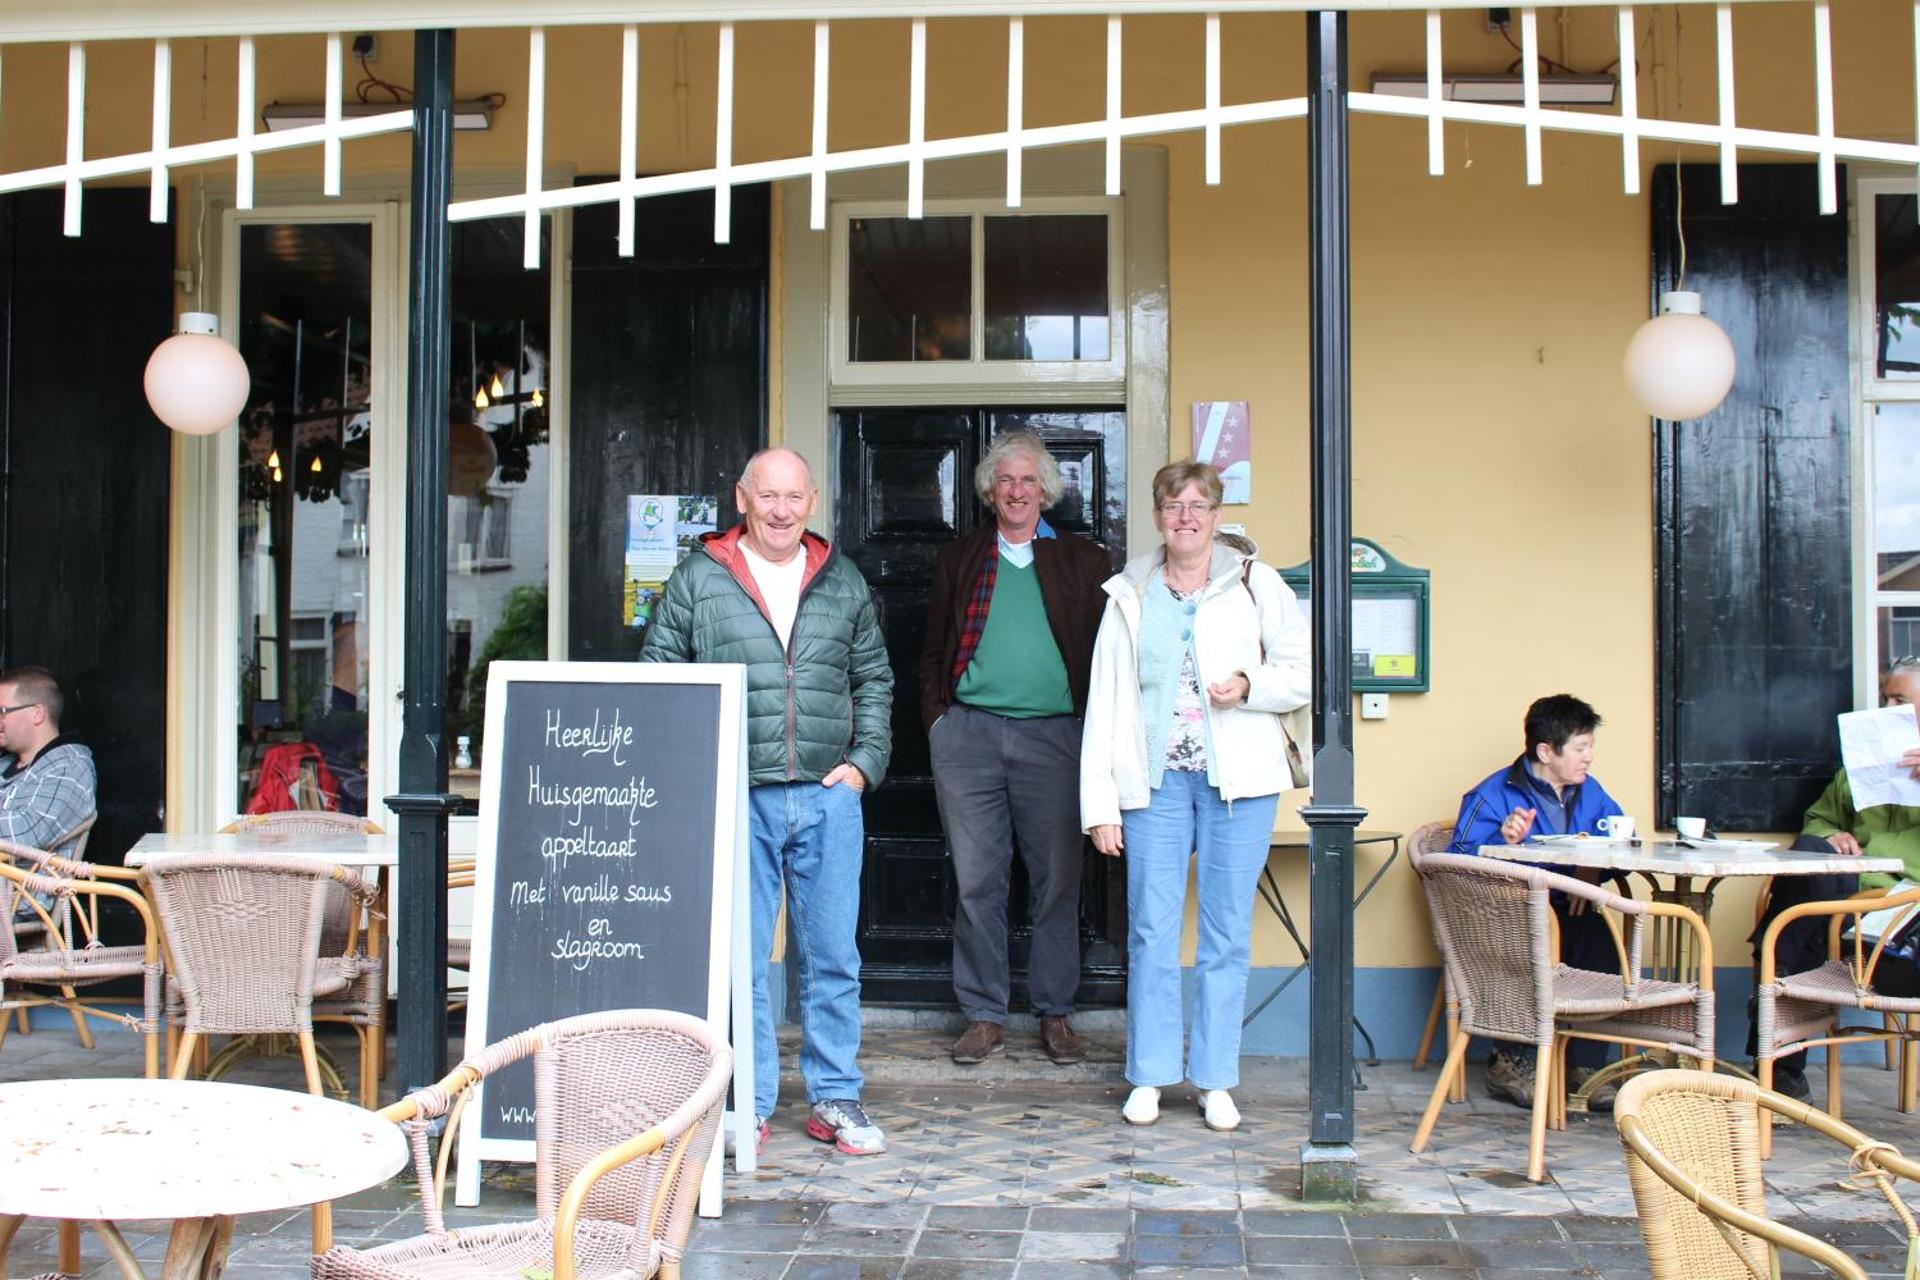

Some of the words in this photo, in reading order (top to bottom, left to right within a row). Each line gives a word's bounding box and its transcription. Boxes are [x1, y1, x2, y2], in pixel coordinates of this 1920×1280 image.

[545, 708, 634, 766] Heerlijke
[528, 765, 659, 826] Huisgemaakte
[541, 825, 637, 873] appeltaart
[510, 877, 546, 905] Met
[562, 874, 619, 904] vanille
[624, 884, 672, 902] saus
[588, 918, 613, 936] en
[551, 930, 645, 970] slagroom
